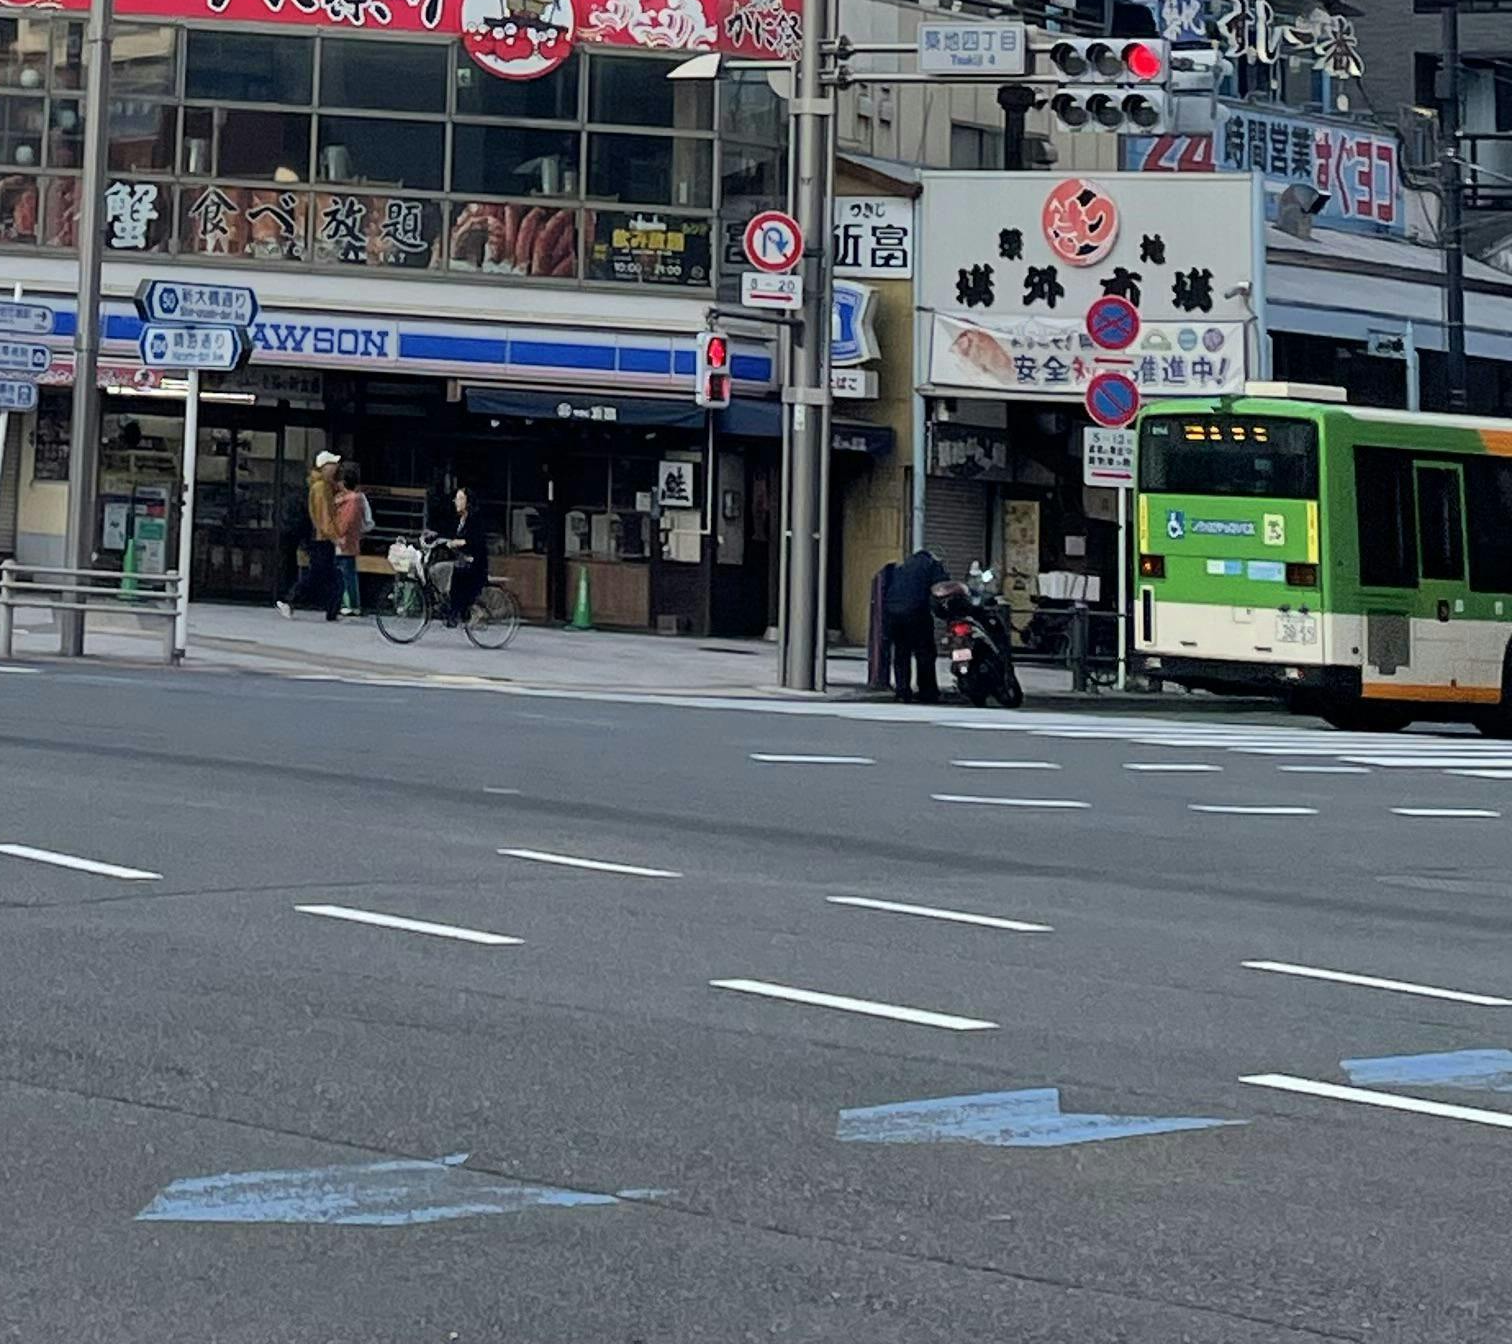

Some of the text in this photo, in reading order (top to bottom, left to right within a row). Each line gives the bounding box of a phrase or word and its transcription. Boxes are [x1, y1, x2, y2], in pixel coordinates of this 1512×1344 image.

[725, 0, 803, 62] かに祭
[924, 29, 1018, 53] 築地四丁目
[1225, 115, 1311, 179] 時間営業
[104, 181, 428, 253] 蟹 食べ放題
[849, 201, 886, 218] つきじ
[254, 320, 390, 357] AWSON
[1013, 353, 1228, 387] 安全推進中!
